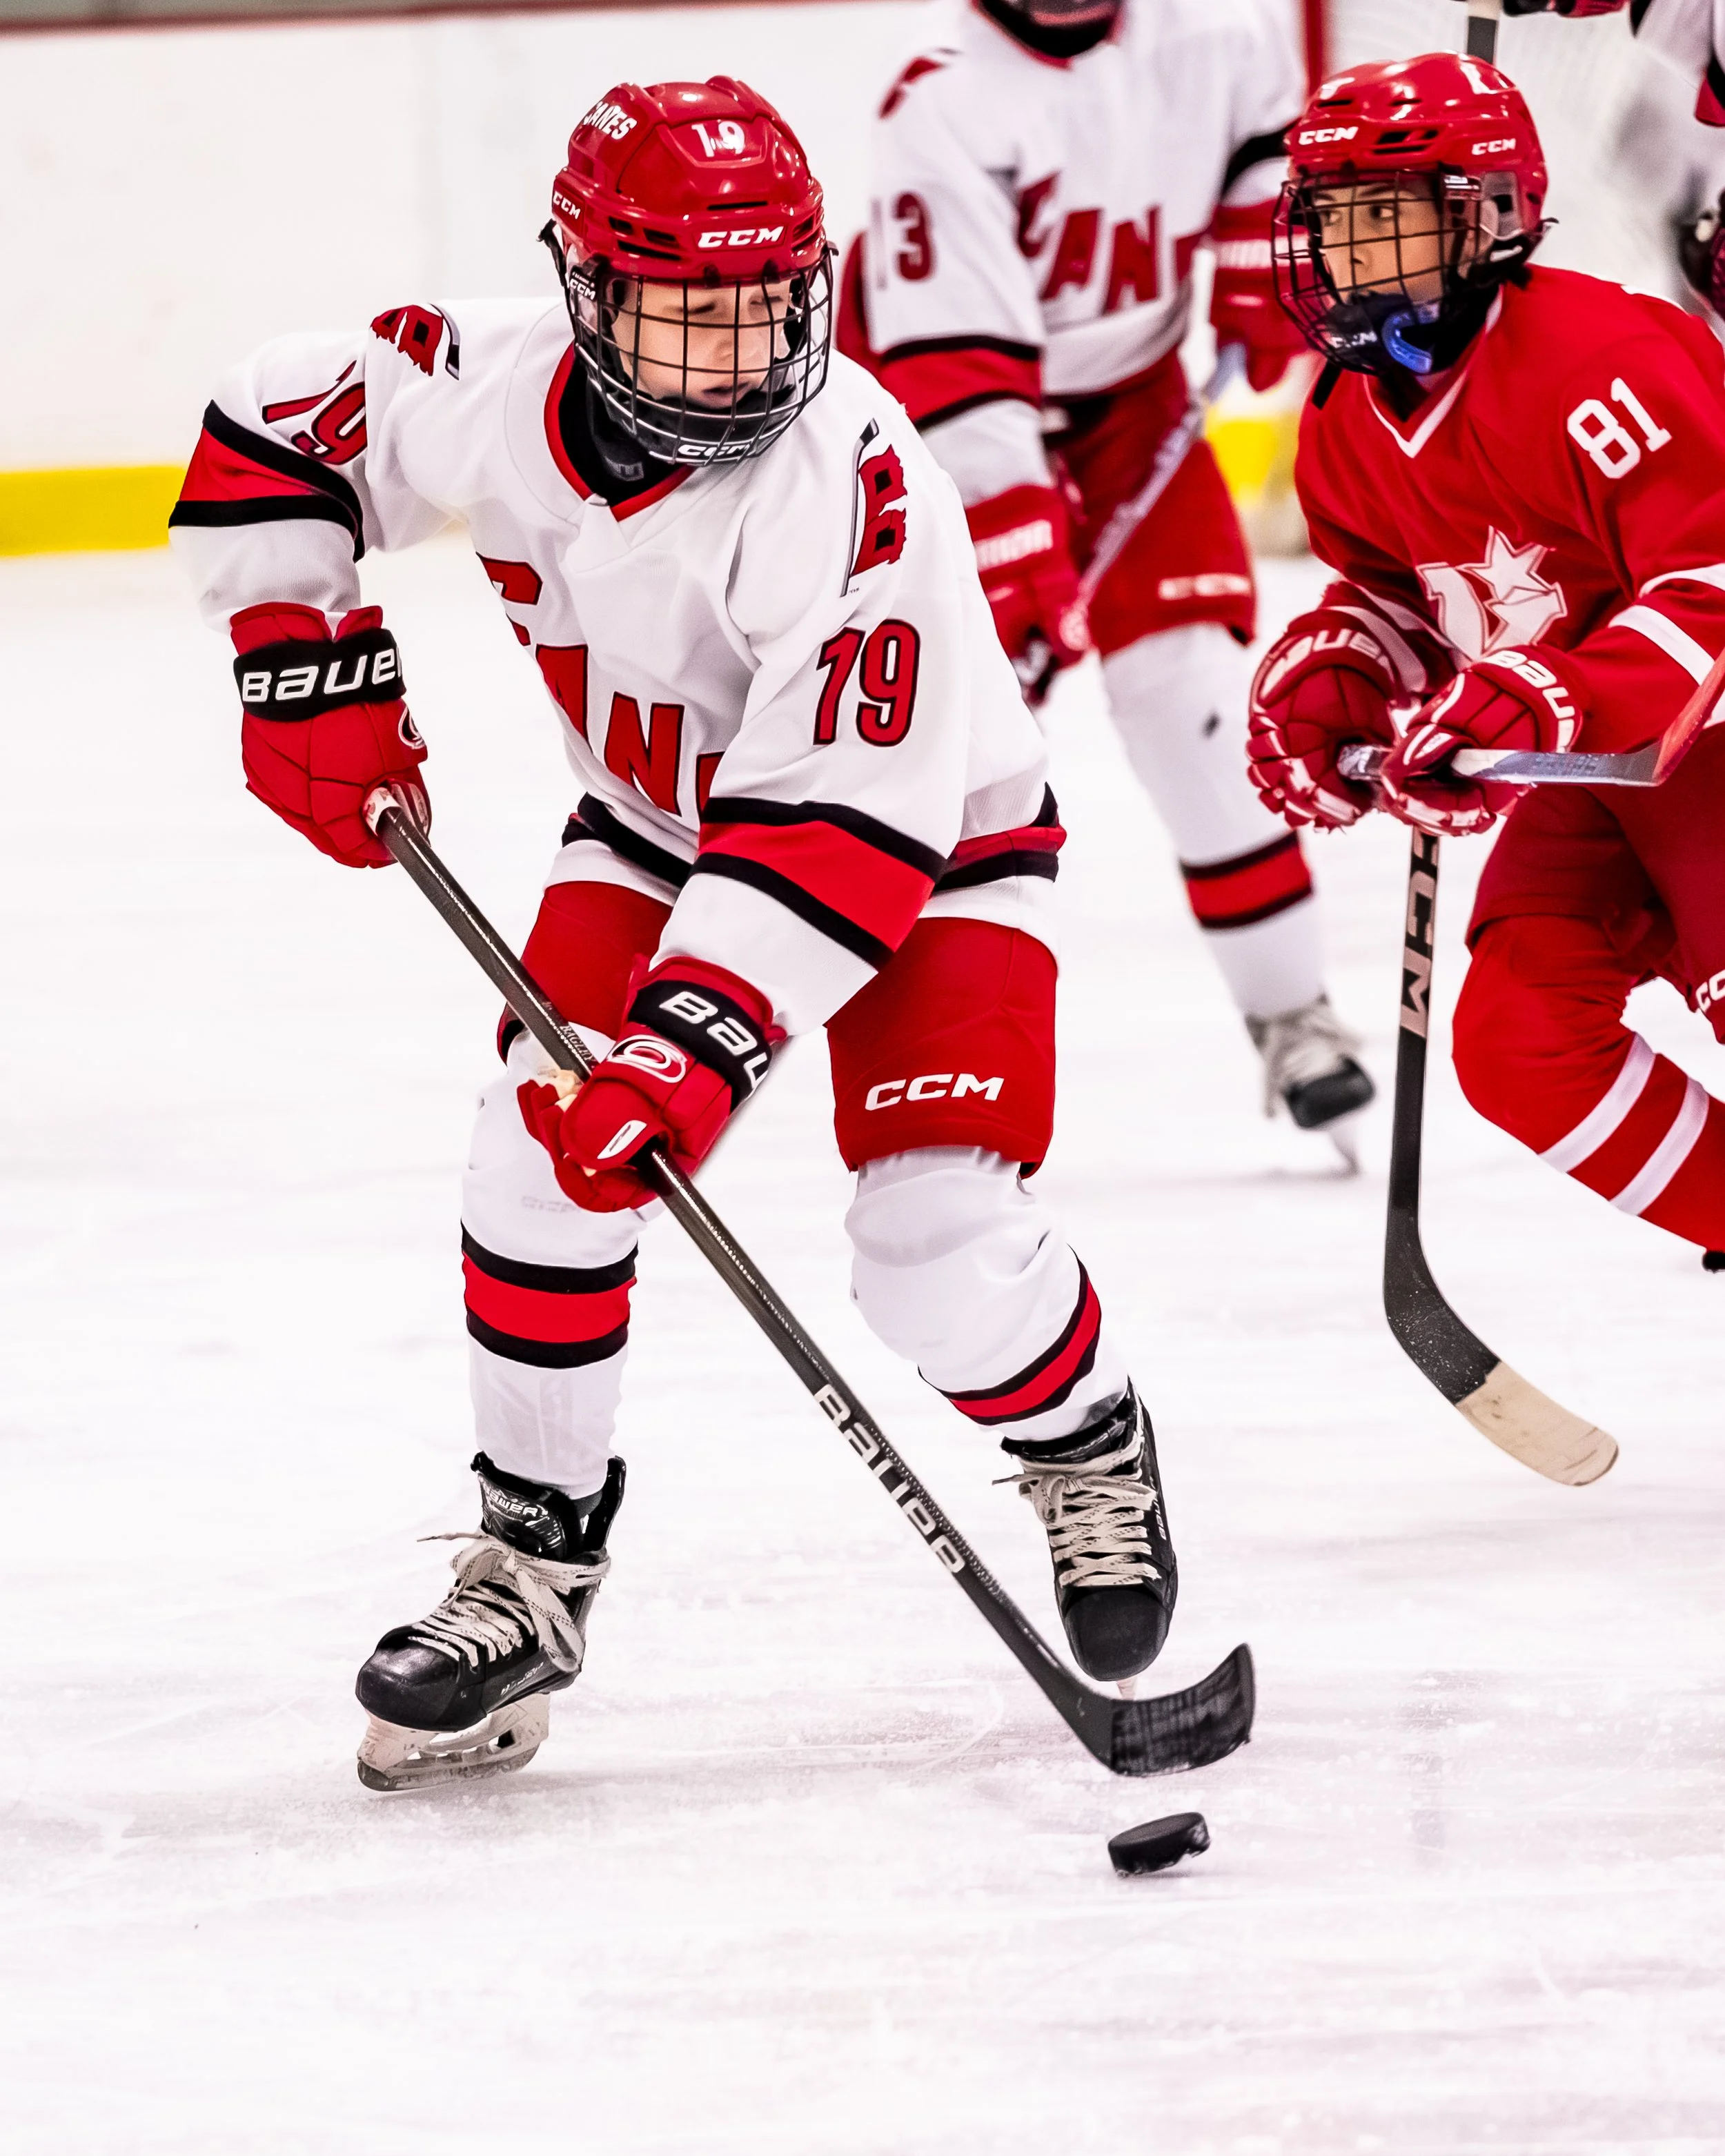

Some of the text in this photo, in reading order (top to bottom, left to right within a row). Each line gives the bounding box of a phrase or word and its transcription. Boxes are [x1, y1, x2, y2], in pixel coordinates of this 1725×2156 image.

[691, 121, 745, 157] 19
[1298, 127, 1358, 145] CCM
[1471, 138, 1516, 155] CCM
[552, 190, 581, 219] CCM
[698, 227, 784, 248] CCM
[570, 278, 596, 300] CCM
[1567, 377, 1673, 479] 81
[813, 619, 920, 748] 19
[865, 1074, 1005, 1111] CCM
